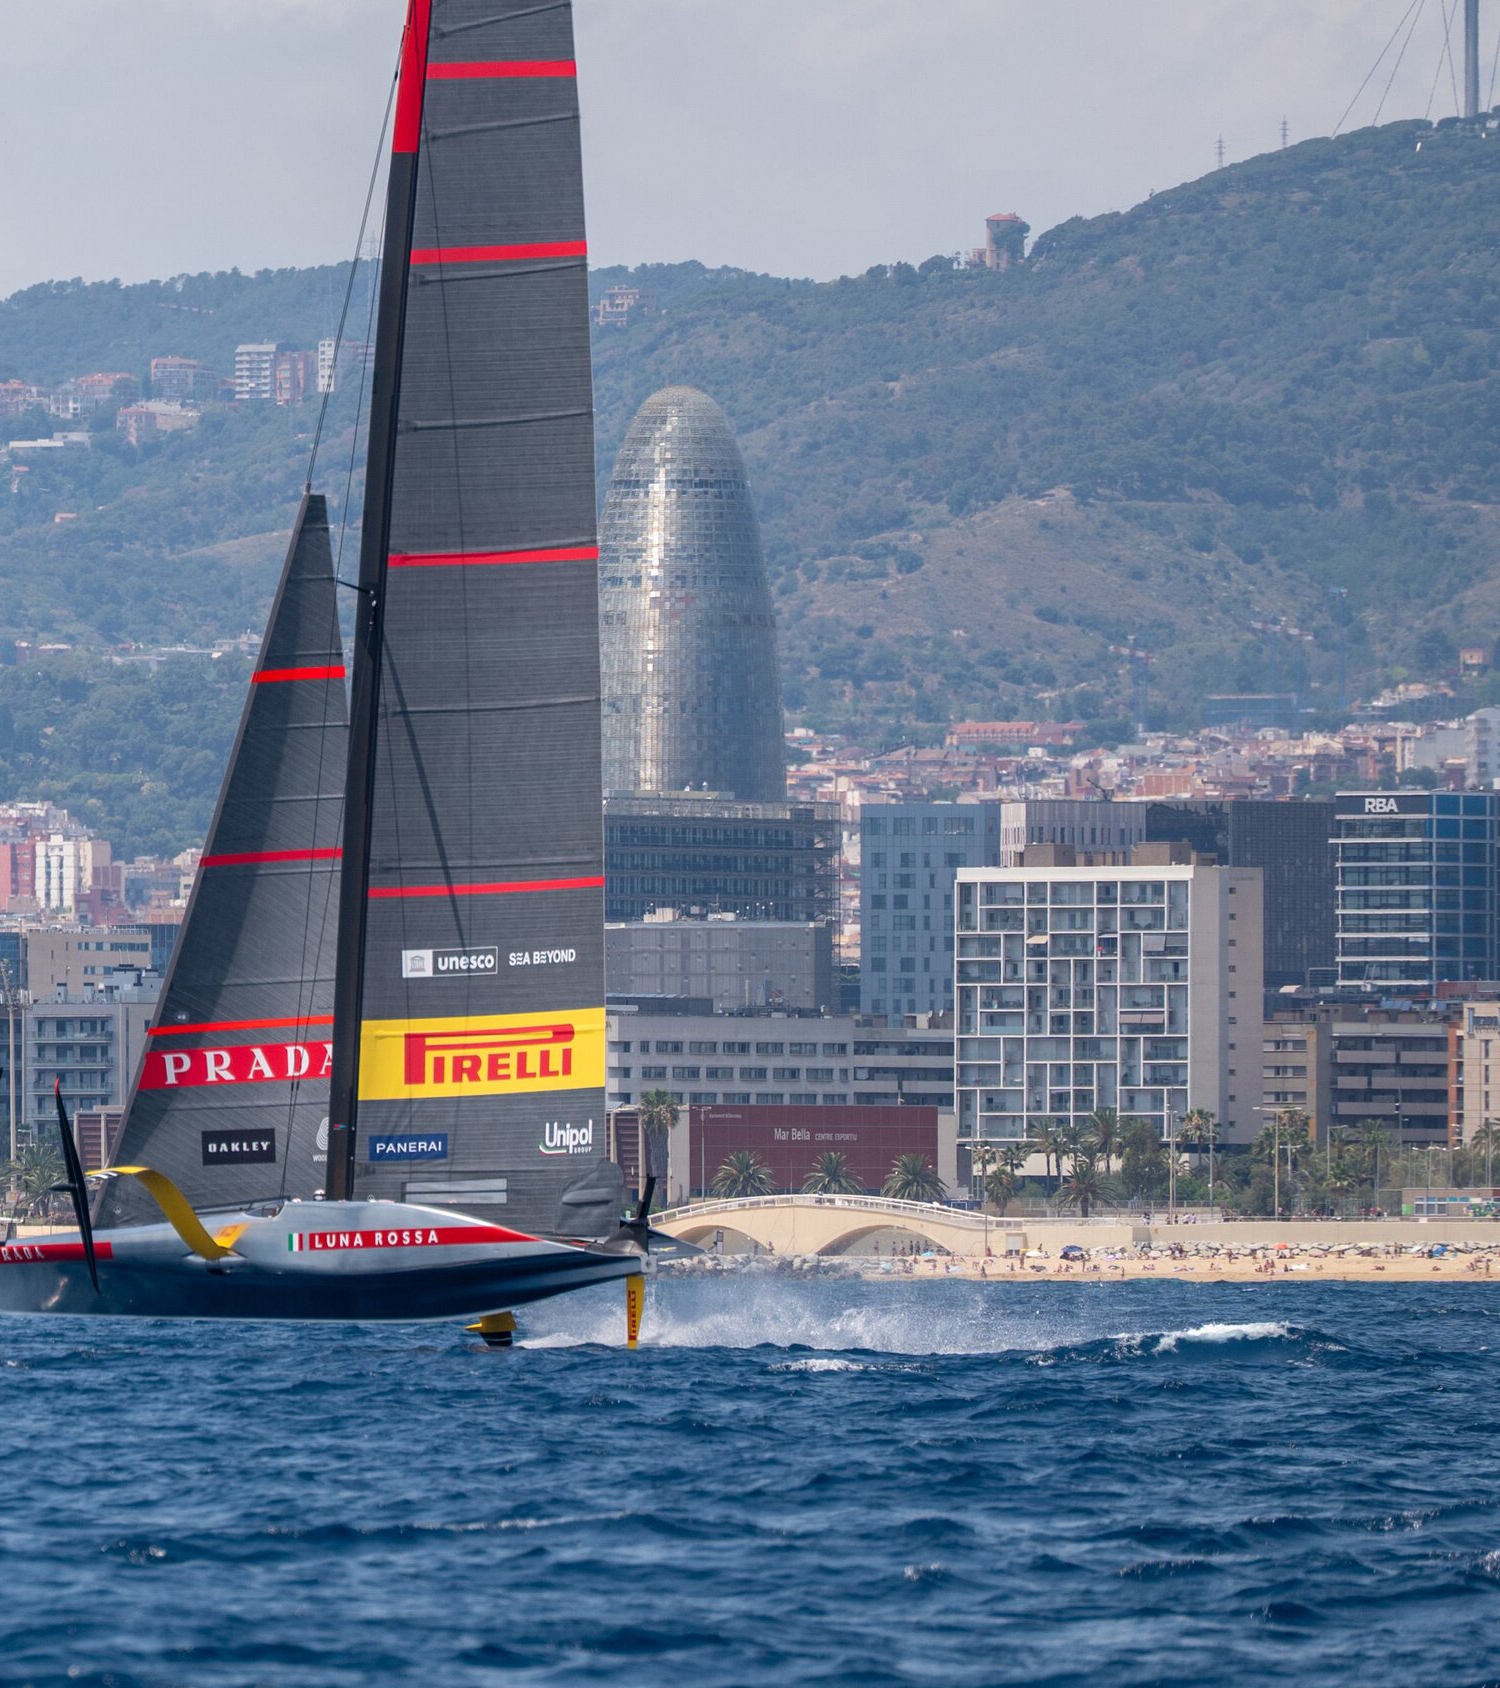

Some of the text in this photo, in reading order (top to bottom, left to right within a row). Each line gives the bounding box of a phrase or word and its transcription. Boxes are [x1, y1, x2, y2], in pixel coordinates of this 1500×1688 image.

[1364, 798, 1399, 813] RBA
[437, 954, 495, 971] unesco
[509, 949, 577, 966] SEA BEYOND
[404, 1023, 575, 1086] PIRELLI
[544, 1119, 593, 1155] Unipol
[774, 1128, 789, 1140] Mar
[791, 1128, 810, 1140] Bella
[208, 1141, 270, 1153] OAKLEY
[375, 1140, 442, 1154] PANERAI
[573, 1146, 592, 1154] GROUP
[314, 1229, 439, 1249] LUNA ROSSA
